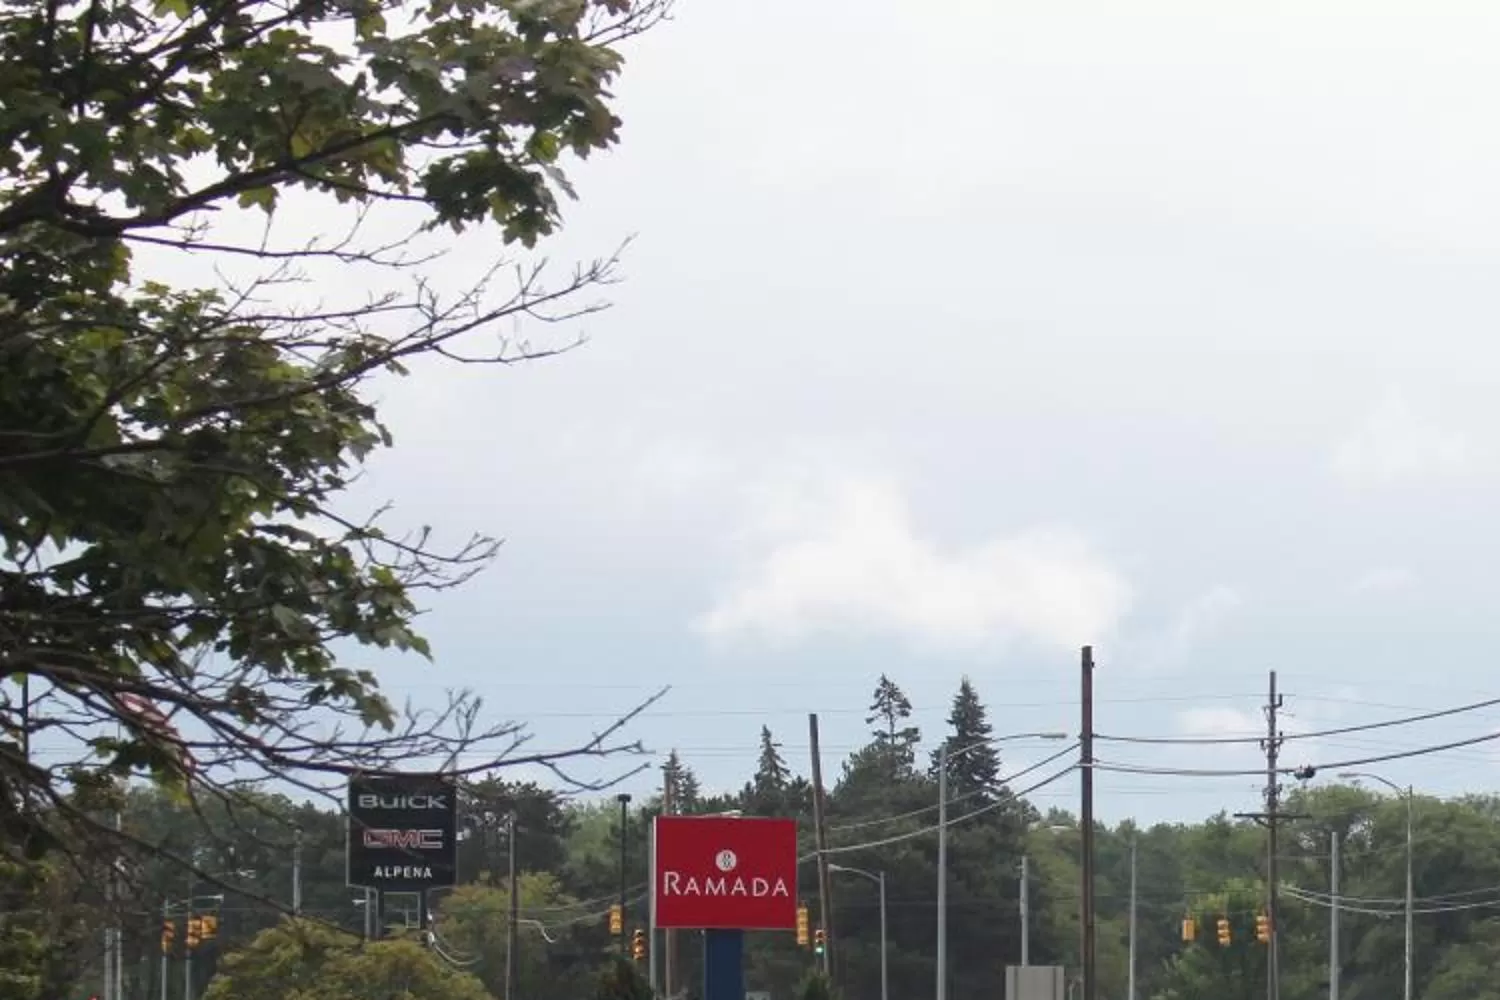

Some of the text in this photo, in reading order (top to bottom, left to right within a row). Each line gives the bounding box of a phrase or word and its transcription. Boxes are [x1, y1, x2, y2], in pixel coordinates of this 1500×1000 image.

[358, 794, 448, 809] BUICK
[363, 829, 444, 849] GMC
[374, 865, 433, 879] ALPENA
[663, 871, 789, 897] RAMADA
